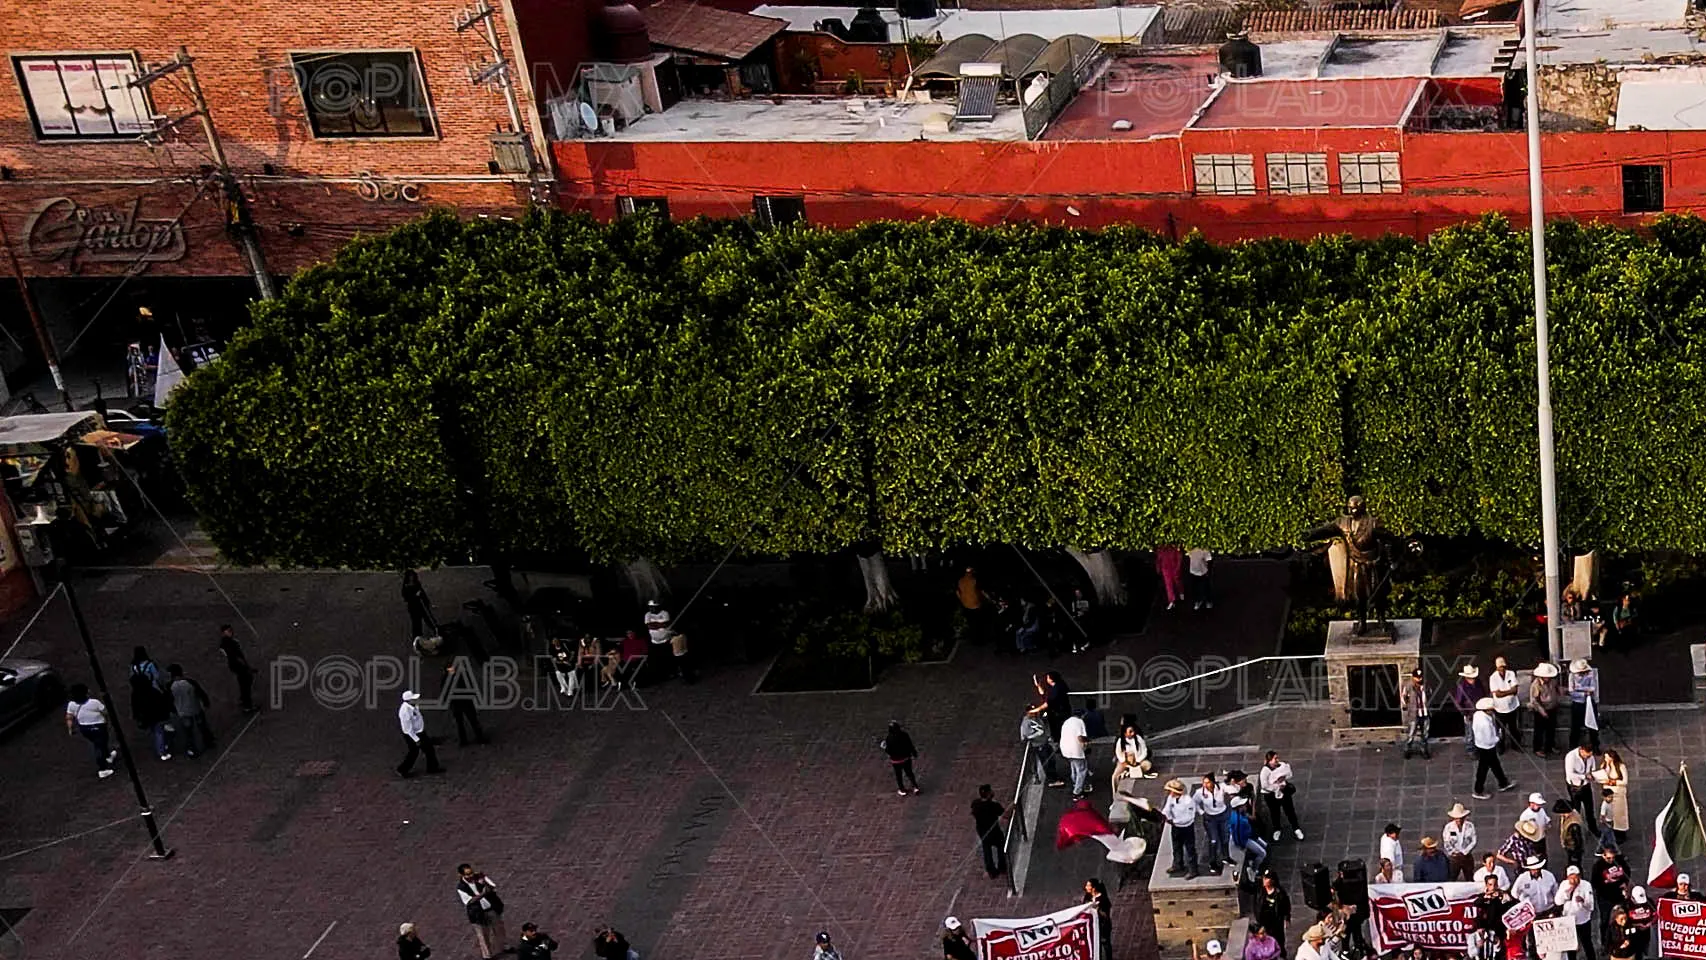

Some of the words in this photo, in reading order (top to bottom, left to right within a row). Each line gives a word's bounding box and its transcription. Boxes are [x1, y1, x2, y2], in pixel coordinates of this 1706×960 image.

[1408, 893, 1445, 913] NO
[1678, 904, 1696, 914] NO
[1020, 925, 1054, 945] NO
[1673, 933, 1684, 941] DE
[1684, 935, 1695, 943] LA
